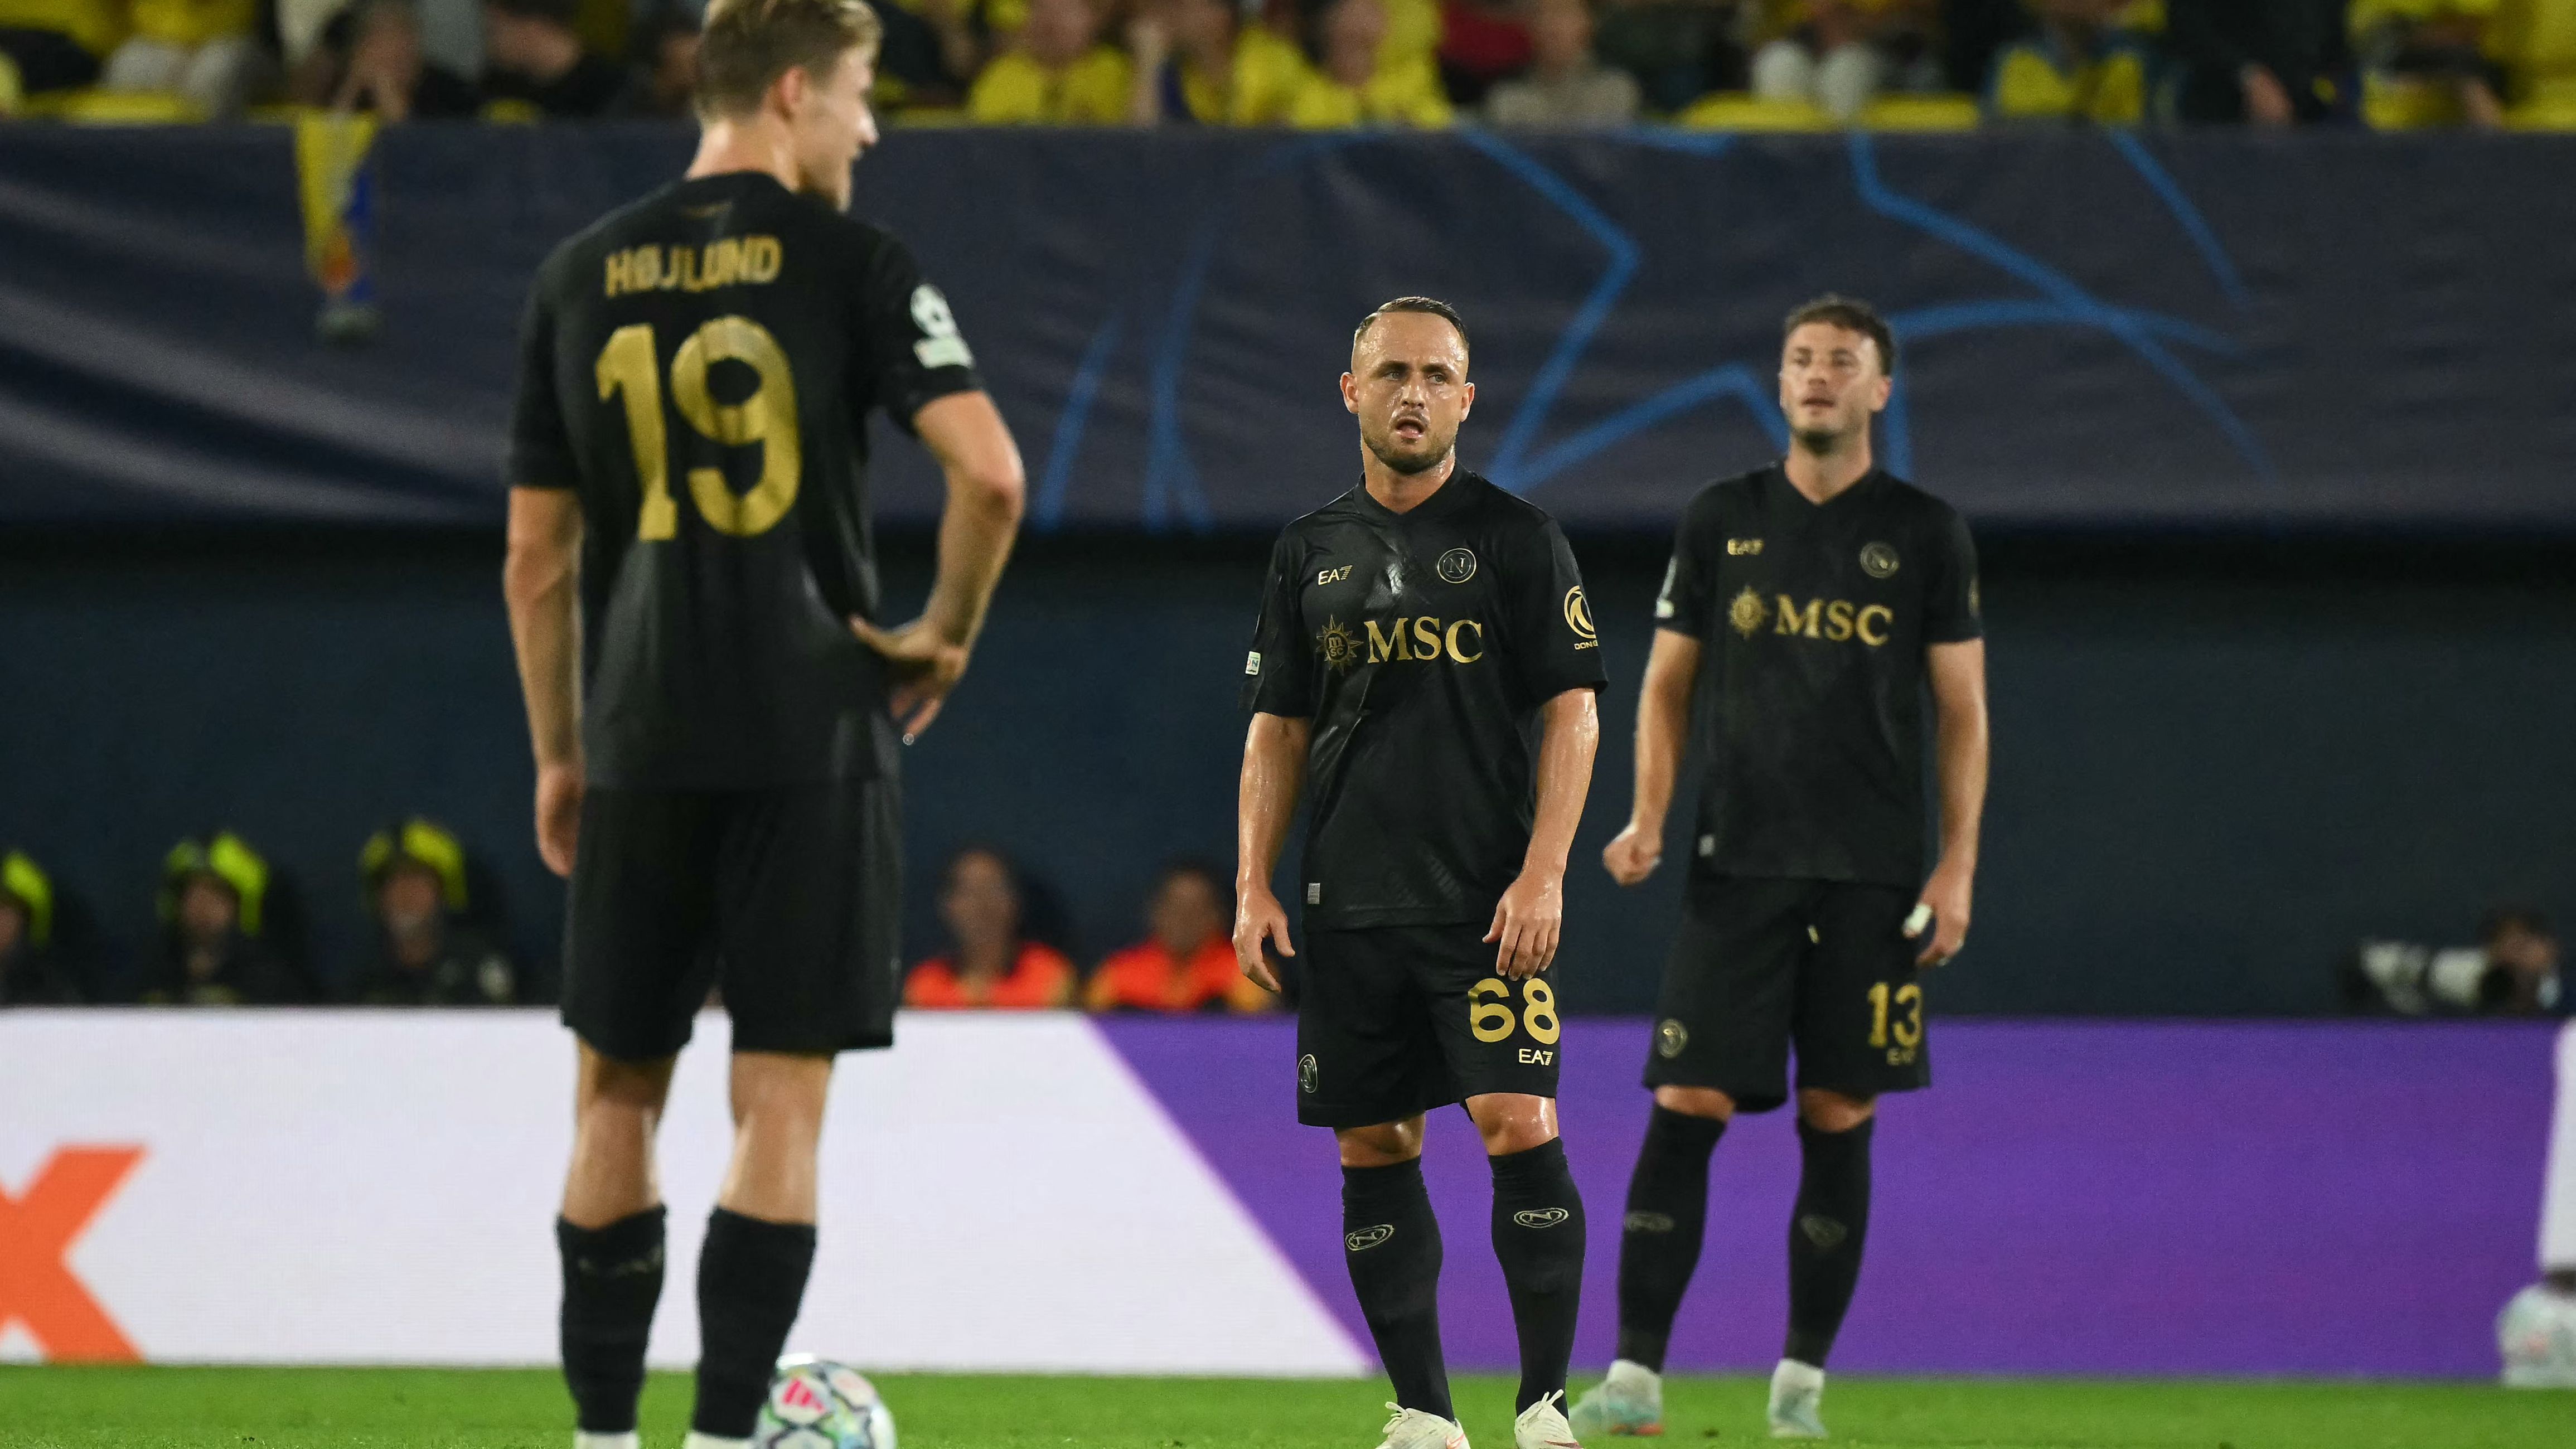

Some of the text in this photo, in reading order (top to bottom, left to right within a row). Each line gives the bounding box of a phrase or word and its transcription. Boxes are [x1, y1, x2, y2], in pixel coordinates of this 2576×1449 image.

[595, 315, 802, 541] 19
[1318, 564, 1353, 585] EA7
[1364, 616, 1483, 663] MSC
[1773, 593, 1893, 647] MSC
[1468, 977, 1560, 1044] 68
[1868, 982, 1923, 1048] 13
[1518, 1048, 1553, 1065] EA7
